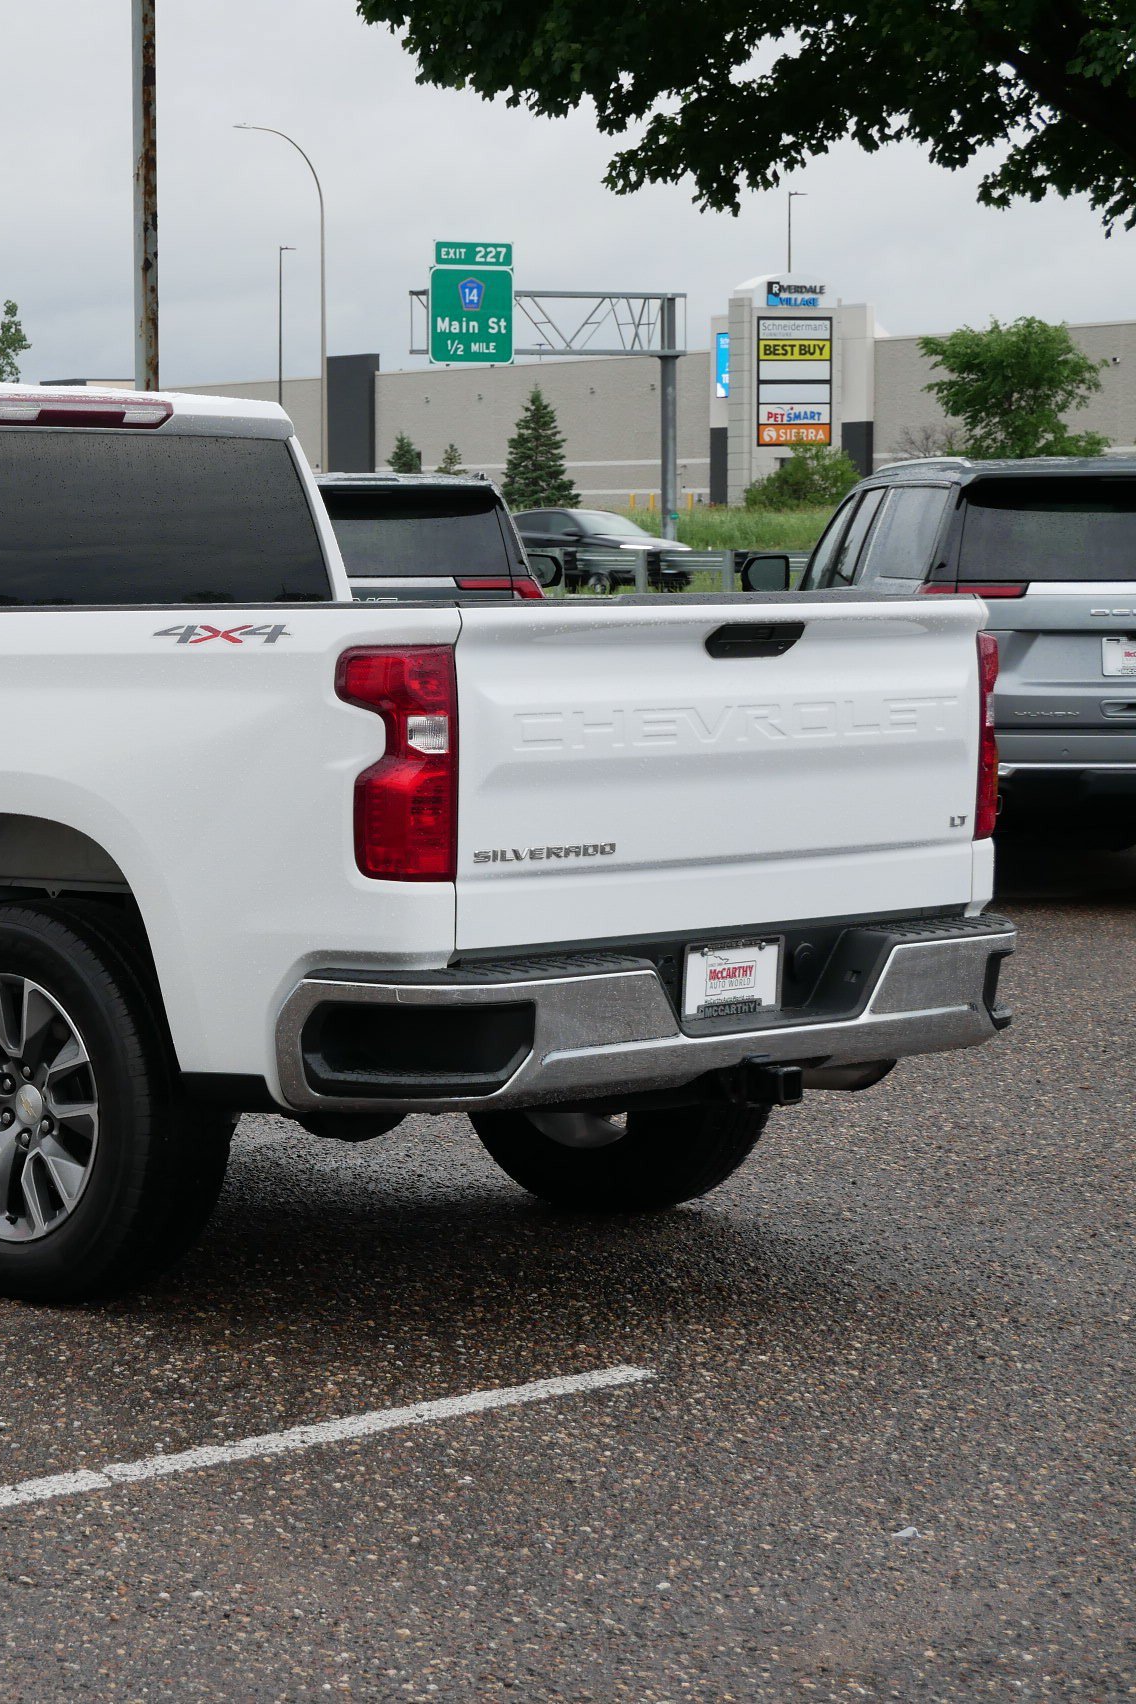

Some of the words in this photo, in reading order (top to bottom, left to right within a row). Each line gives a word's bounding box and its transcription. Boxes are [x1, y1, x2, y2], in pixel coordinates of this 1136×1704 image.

[440, 248, 466, 259] EXIT
[475, 247, 506, 262] 227
[464, 288, 479, 303] 14
[772, 283, 826, 295] RIVERDALE
[778, 296, 820, 307] VILLAGE
[436, 317, 479, 333] Main
[488, 317, 507, 334] St
[761, 322, 829, 332] Schneiderman's
[470, 342, 496, 353] MILE
[763, 344, 797, 356] BEST
[798, 344, 826, 356] BUY
[779, 429, 825, 441] SIERRA
[513, 696, 958, 751] CHEVROLET
[949, 814, 968, 828] LT
[473, 842, 616, 864] SILVERADO
[709, 965, 754, 981] McCARTHY
[709, 980, 726, 990] AUTO
[728, 977, 751, 988] WORLD
[704, 1000, 756, 1019] MCCARTHY
